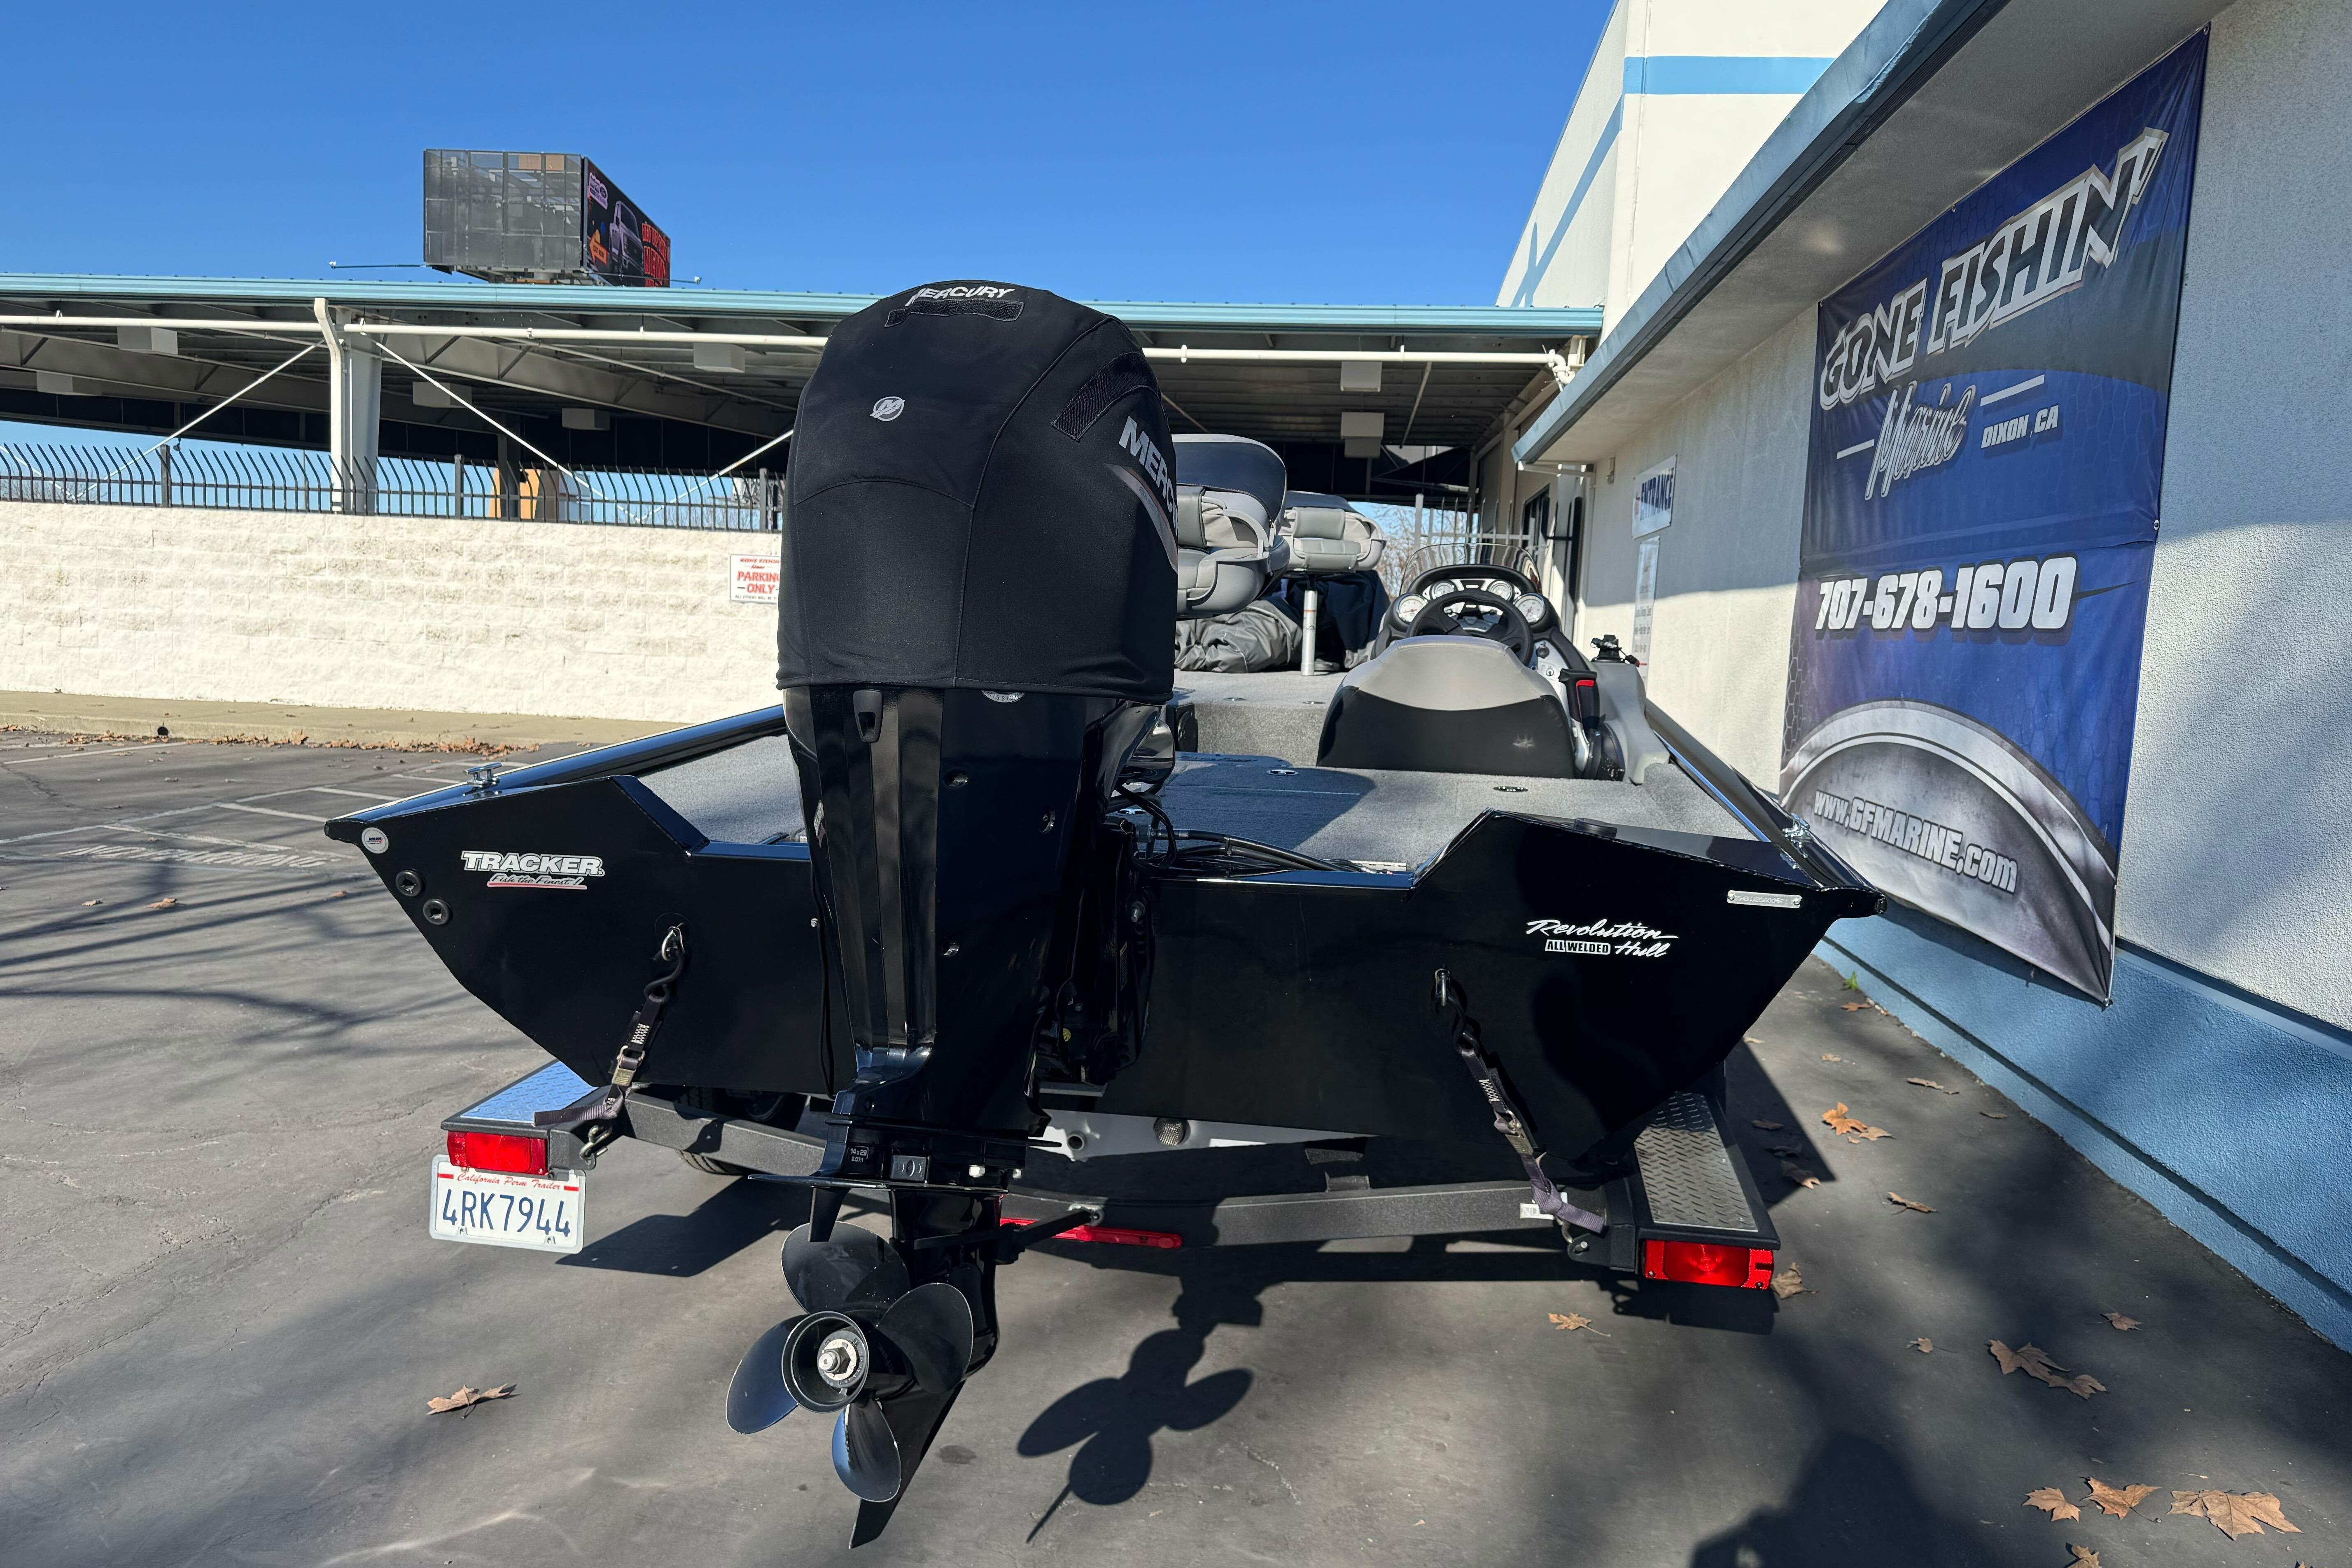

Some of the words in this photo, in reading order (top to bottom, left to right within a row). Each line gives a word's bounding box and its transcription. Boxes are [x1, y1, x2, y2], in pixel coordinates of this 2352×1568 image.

[905, 286, 1015, 307] MERCURY
[1820, 279, 1927, 410] GONE
[1865, 380, 1976, 501] Marine
[1640, 467, 1674, 521] ENTRANCE
[747, 583, 775, 594] ONLY
[1815, 556, 2077, 630] 707-678-1600
[492, 875, 515, 883] Fish
[1526, 919, 1680, 939] Revolution
[1568, 942, 1608, 953] WELDED
[1614, 941, 1671, 958] Hull
[457, 1172, 500, 1185] California
[504, 1176, 527, 1187] Perm
[532, 1179, 561, 1190] Trailer
[442, 1188, 571, 1237] 4RK7944
